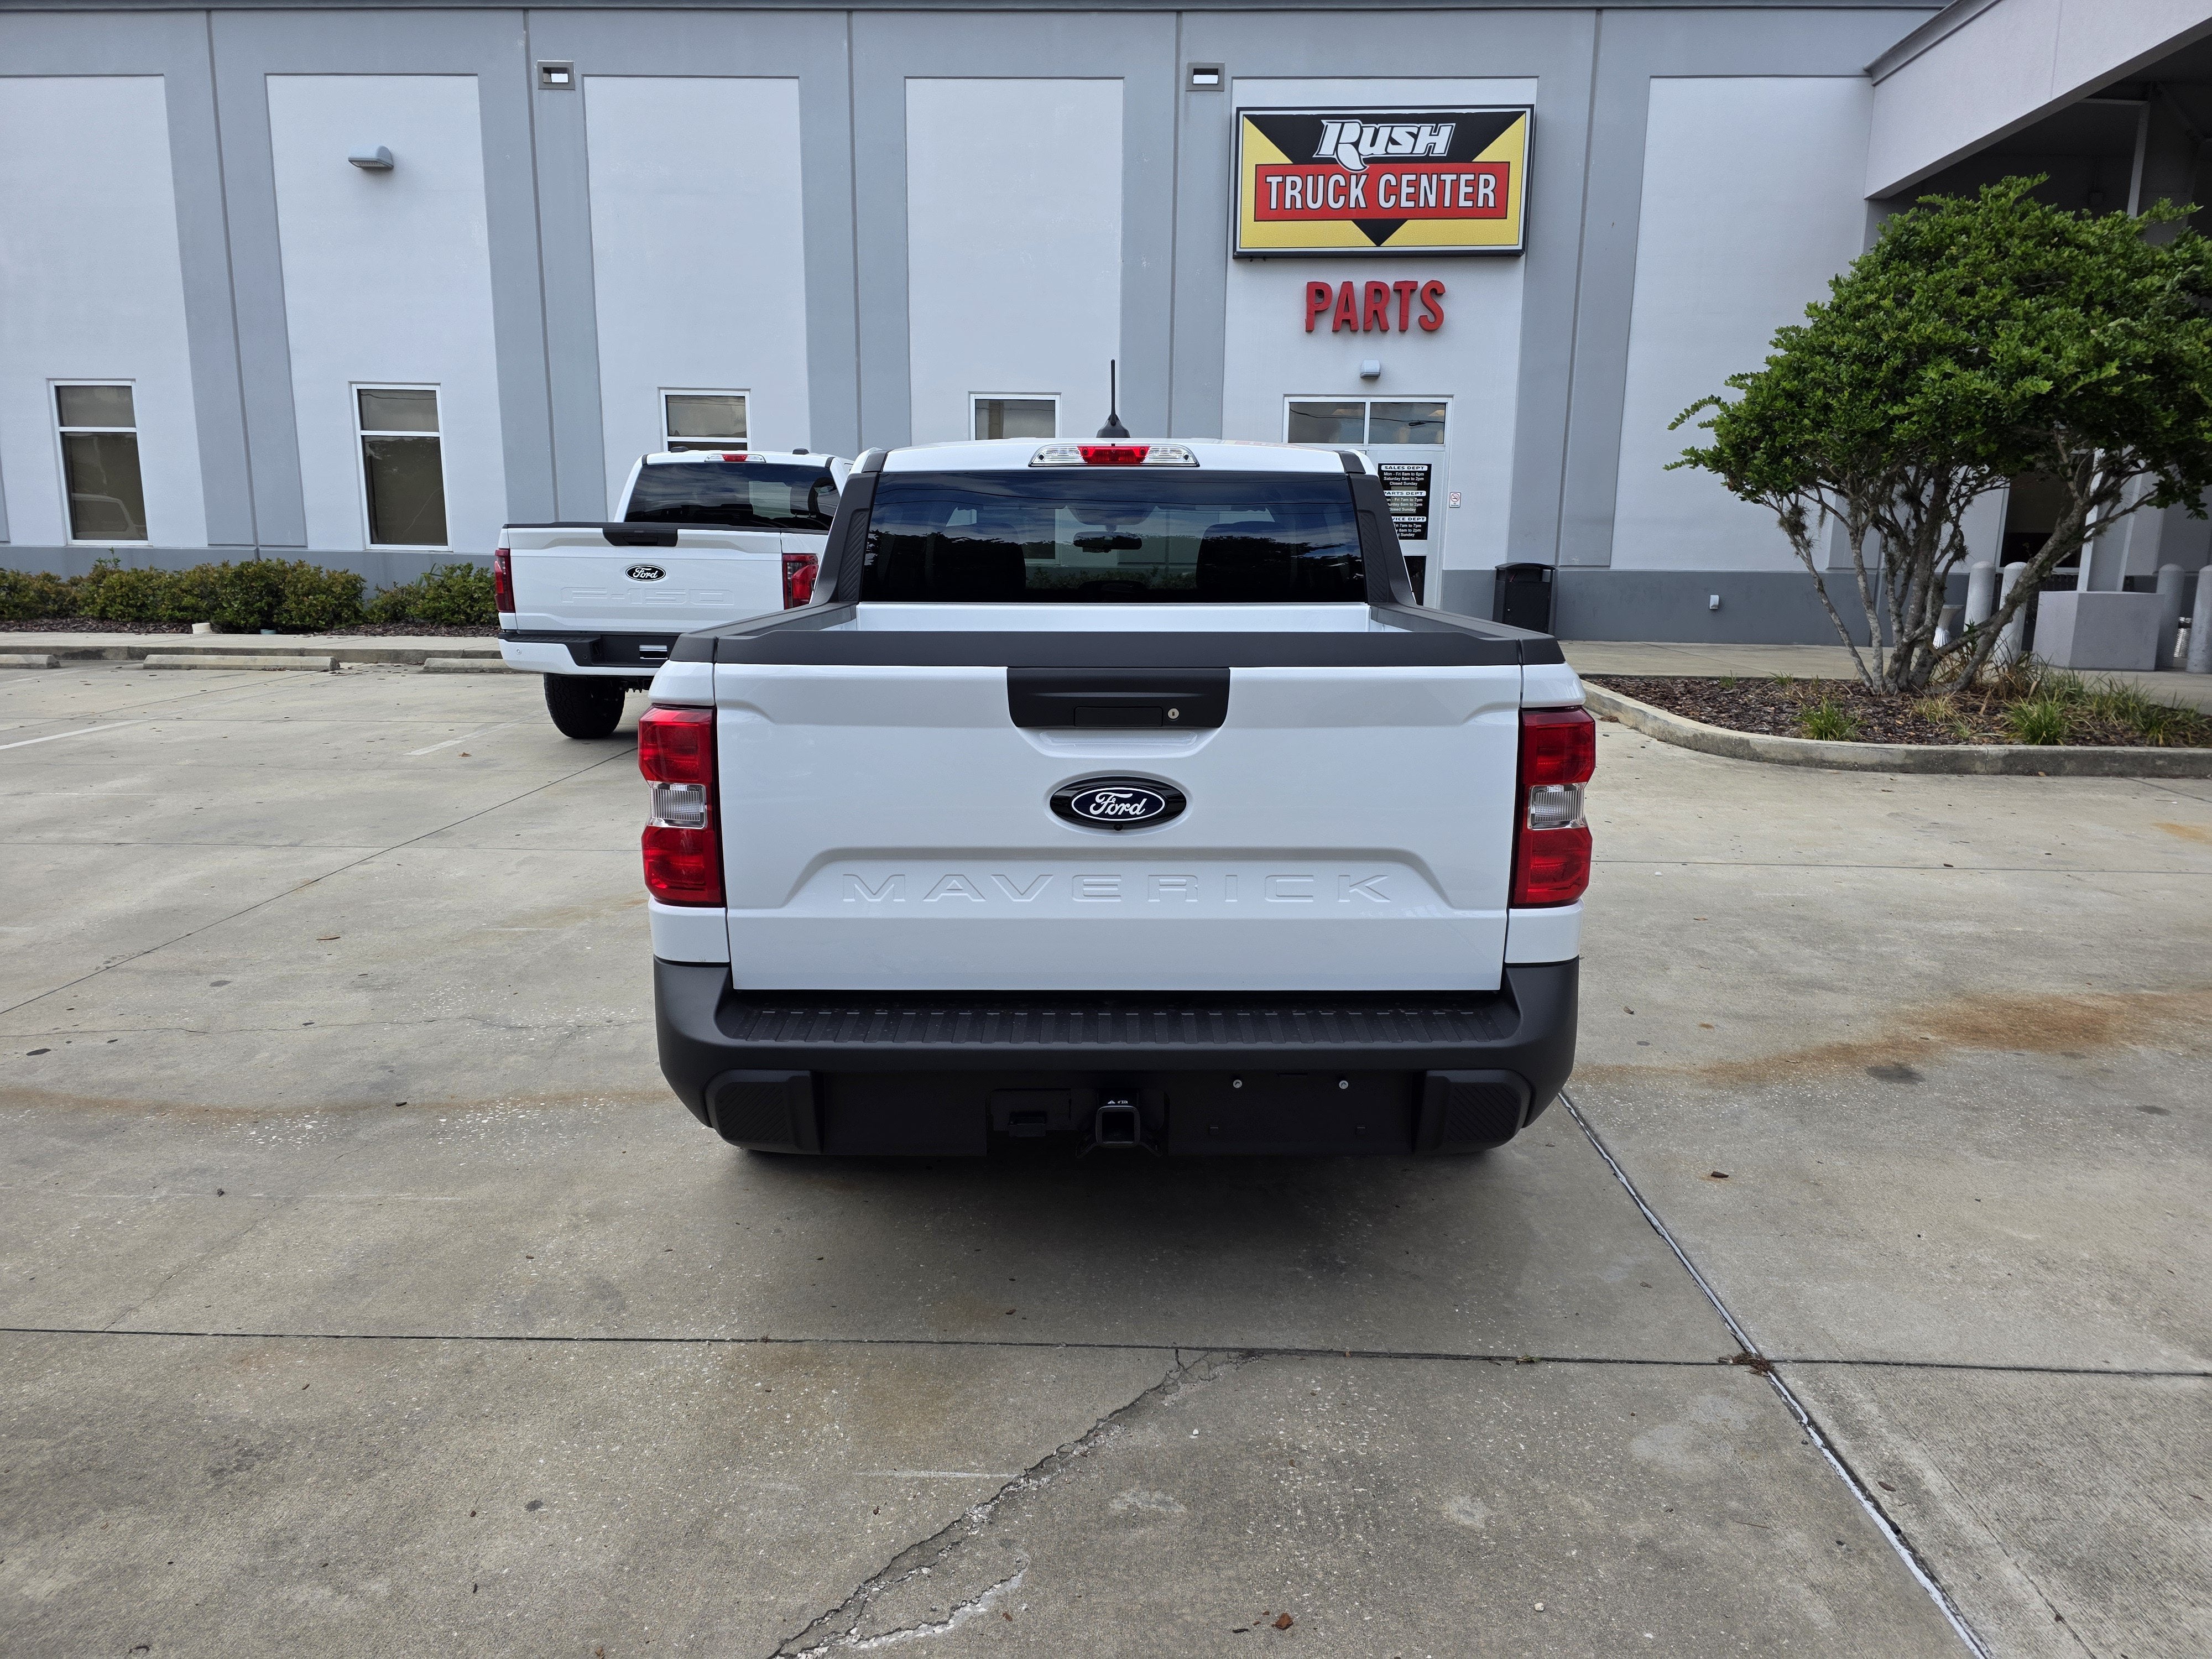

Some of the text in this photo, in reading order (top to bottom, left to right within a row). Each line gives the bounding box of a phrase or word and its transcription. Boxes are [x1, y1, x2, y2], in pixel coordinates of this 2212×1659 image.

[1314, 120, 1455, 172] RUSH
[1266, 174, 1497, 210] TRUCK CENTER
[1306, 280, 1446, 332] PARTS
[633, 565, 658, 578] Ford
[560, 587, 734, 606] F-150
[1089, 792, 1147, 815] Ford
[842, 873, 1392, 903] MAVERICK
